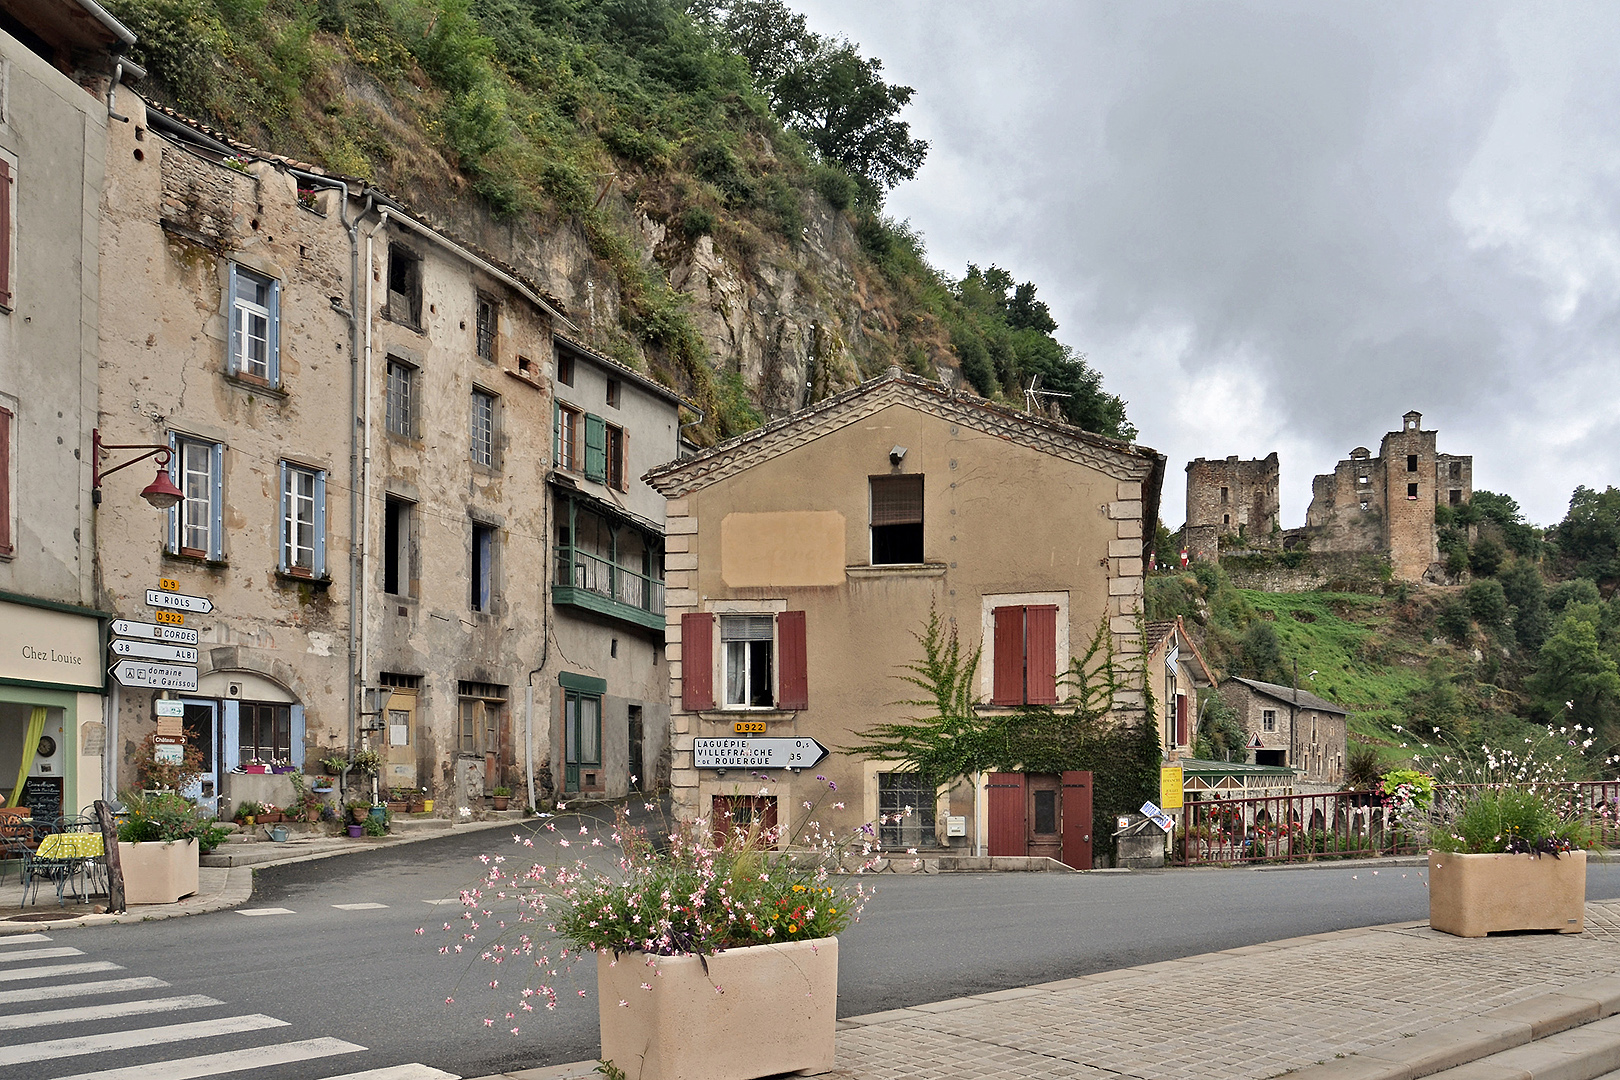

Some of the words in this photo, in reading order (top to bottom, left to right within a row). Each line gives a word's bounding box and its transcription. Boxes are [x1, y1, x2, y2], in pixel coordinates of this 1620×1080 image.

[170, 581, 176, 589] 9
[148, 594, 159, 603] LE
[164, 596, 190, 608] RIOLS
[201, 602, 206, 610] 7
[157, 613, 162, 621] D
[165, 614, 182, 623] 922
[119, 623, 129, 632] 13
[164, 629, 196, 642] CORDES
[119, 643, 130, 652] 38
[22, 645, 47, 661] Chez
[51, 649, 82, 665] Louise
[175, 650, 196, 659] ALBI
[148, 666, 182, 676] domaine
[148, 677, 157, 685] Le
[161, 677, 196, 688] Garissou
[697, 739, 746, 748] LAGUÉPIE
[715, 757, 770, 765] ROUERGUE
[789, 753, 802, 761] 35
